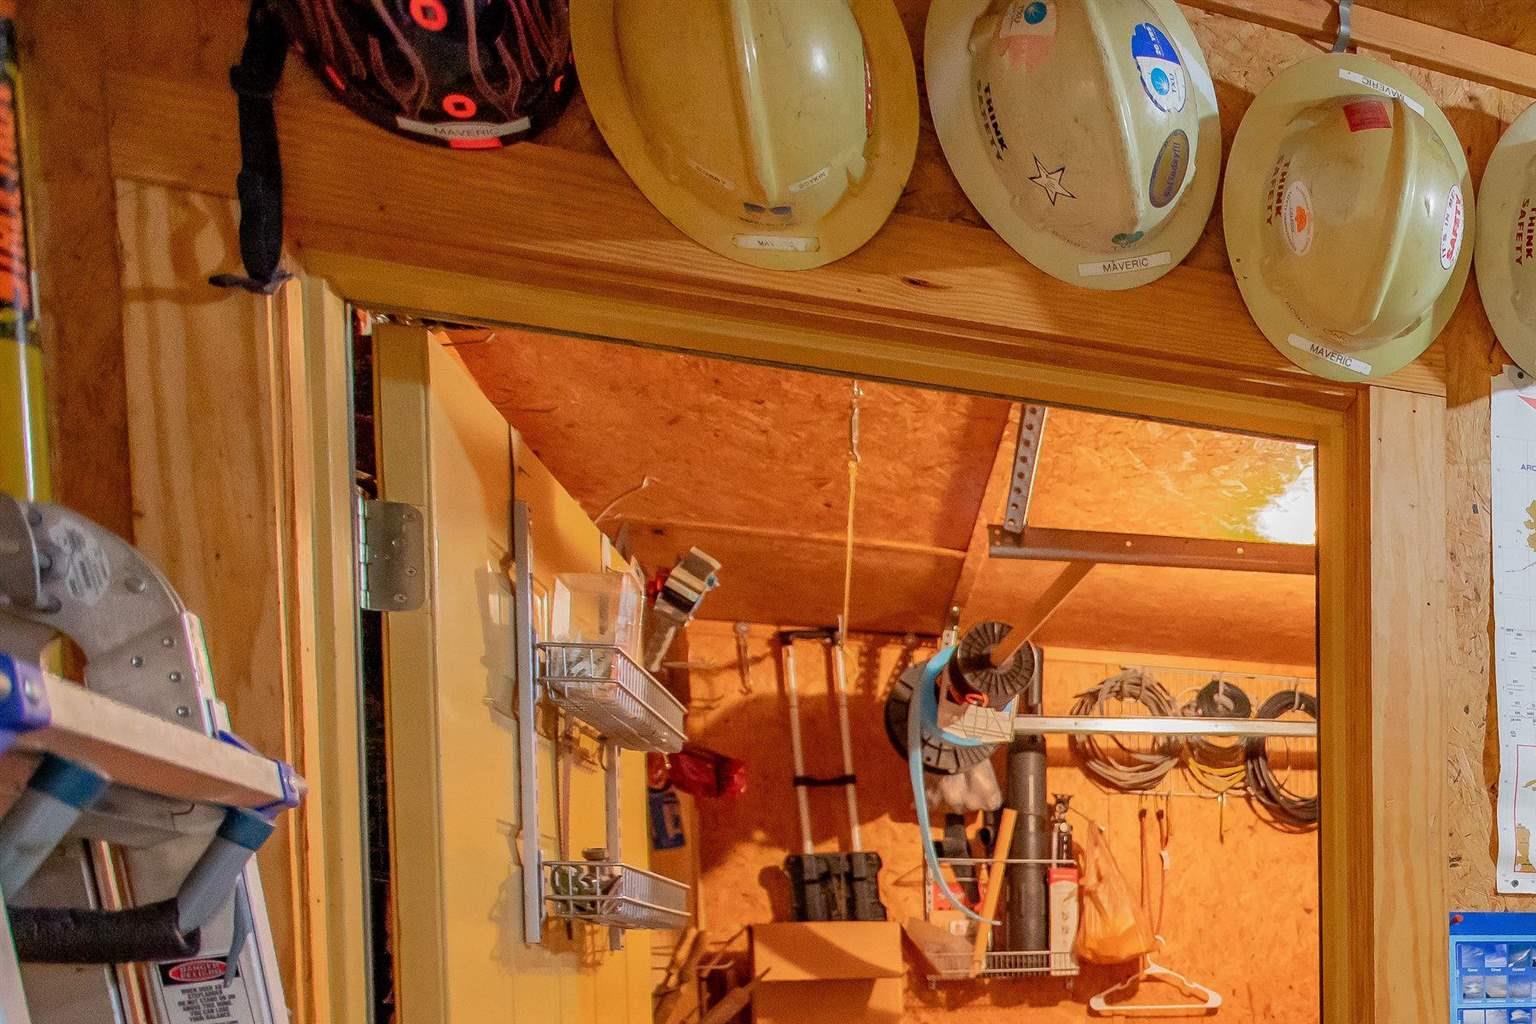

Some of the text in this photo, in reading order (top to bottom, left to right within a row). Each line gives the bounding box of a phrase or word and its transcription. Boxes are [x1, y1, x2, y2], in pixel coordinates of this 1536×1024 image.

[984, 82, 1008, 151] THINK
[1266, 154, 1285, 226] SAFETY
[1275, 159, 1291, 218] THINK
[1446, 192, 1462, 260] SAFETY
[1514, 198, 1530, 266] SAFETY
[1102, 258, 1150, 272] MAVERIC
[1310, 343, 1352, 368] MAVERIC
